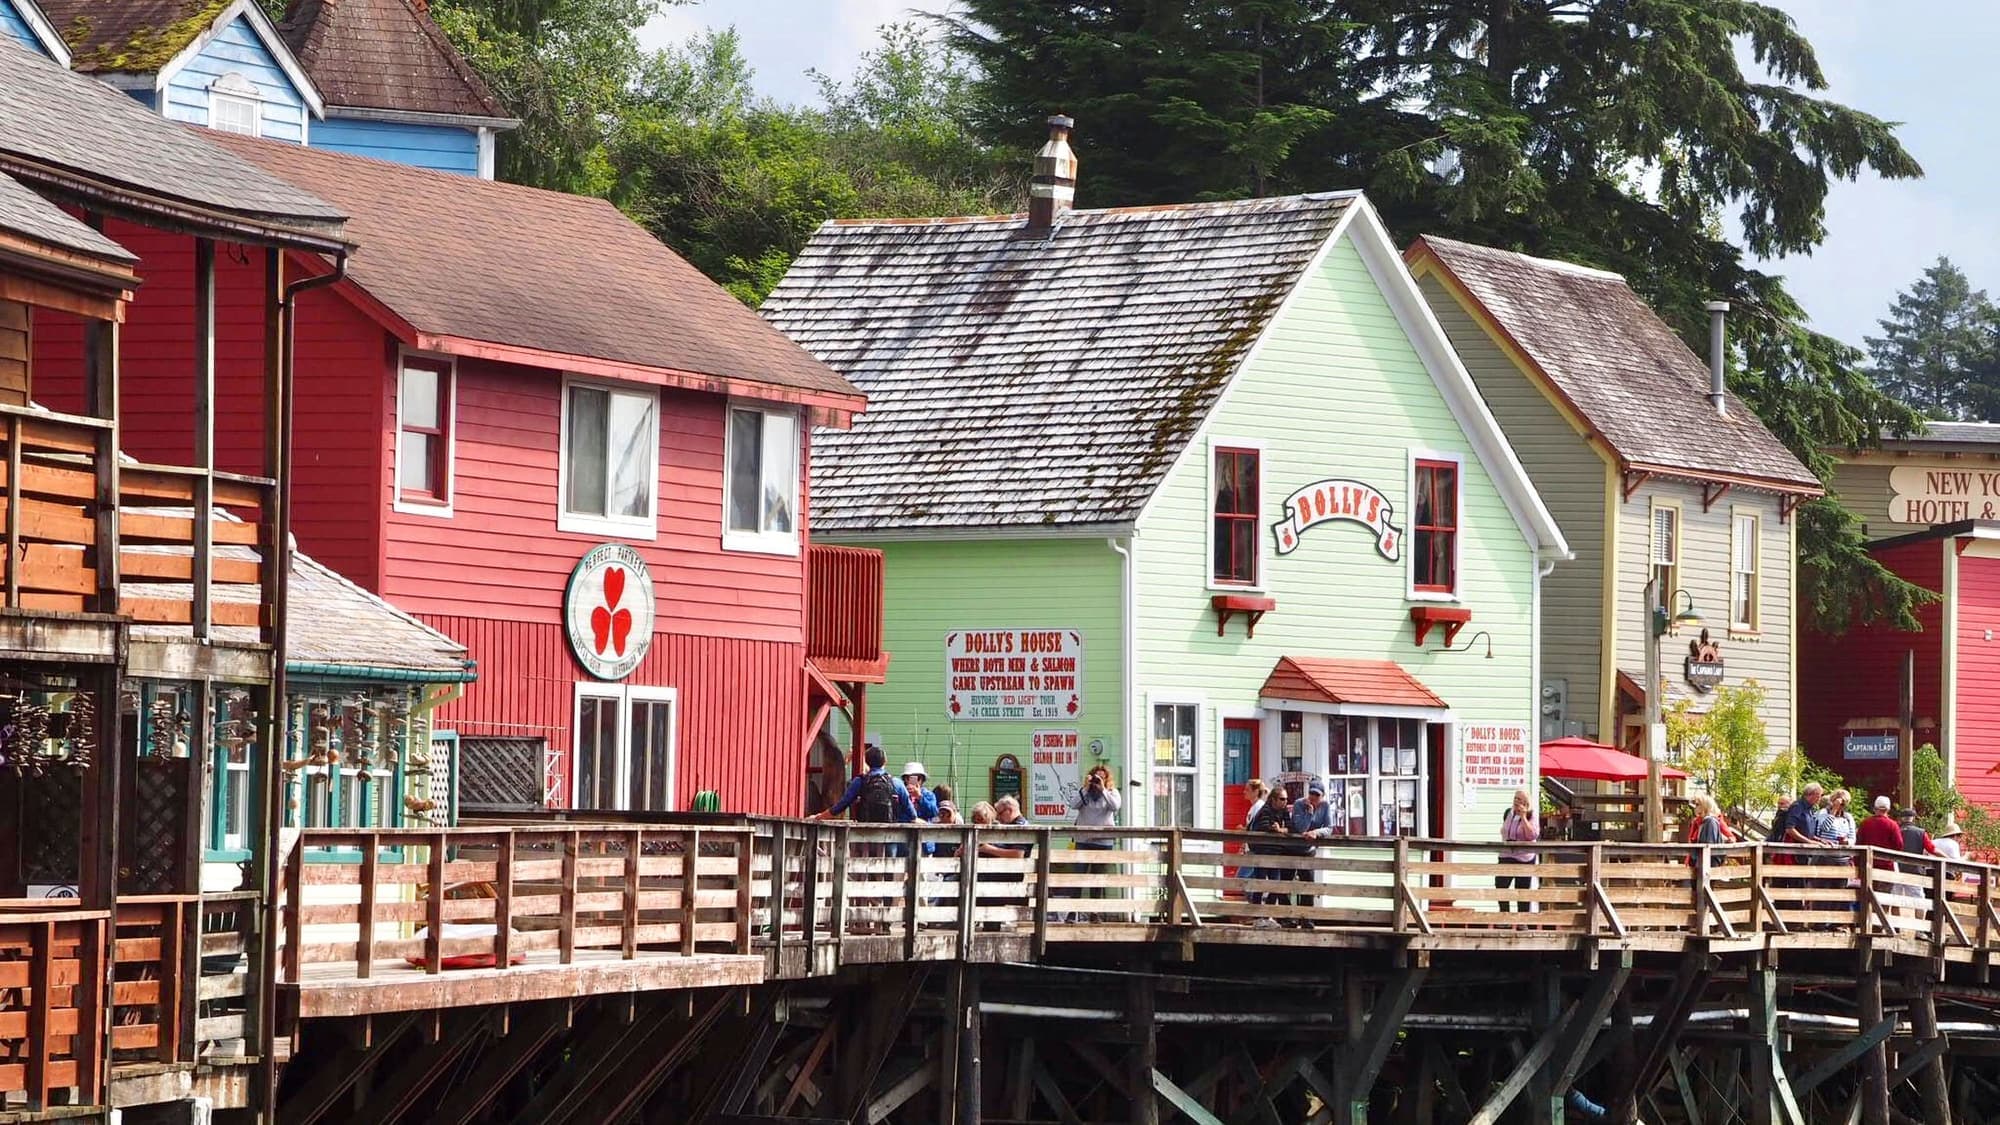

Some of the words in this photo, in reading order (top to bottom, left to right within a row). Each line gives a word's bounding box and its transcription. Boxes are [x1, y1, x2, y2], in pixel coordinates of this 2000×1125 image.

[1926, 471, 1972, 495] NEW
[1298, 486, 1380, 524] DOLLY'S
[1980, 501, 1996, 520] &
[585, 546, 612, 571] PERFECT
[965, 632, 1013, 653] DOLLY'S
[1021, 632, 1062, 653] HOUSE
[952, 658, 980, 672] WHERE
[983, 658, 1005, 672] BOTH
[1008, 658, 1025, 672] MEN
[1030, 657, 1039, 672] &
[1042, 658, 1076, 672] SALMON
[953, 676, 976, 690] CAME
[980, 676, 1025, 690] UPSTREAM
[1029, 676, 1040, 690] TO
[1044, 676, 1075, 690] SPAWN
[971, 695, 999, 705] HISTORIC
[1002, 707, 1025, 717] STREET
[1499, 728, 1520, 740] HOUSE
[1880, 743, 1895, 752] LADY
[1034, 804, 1065, 815] RENTALS
